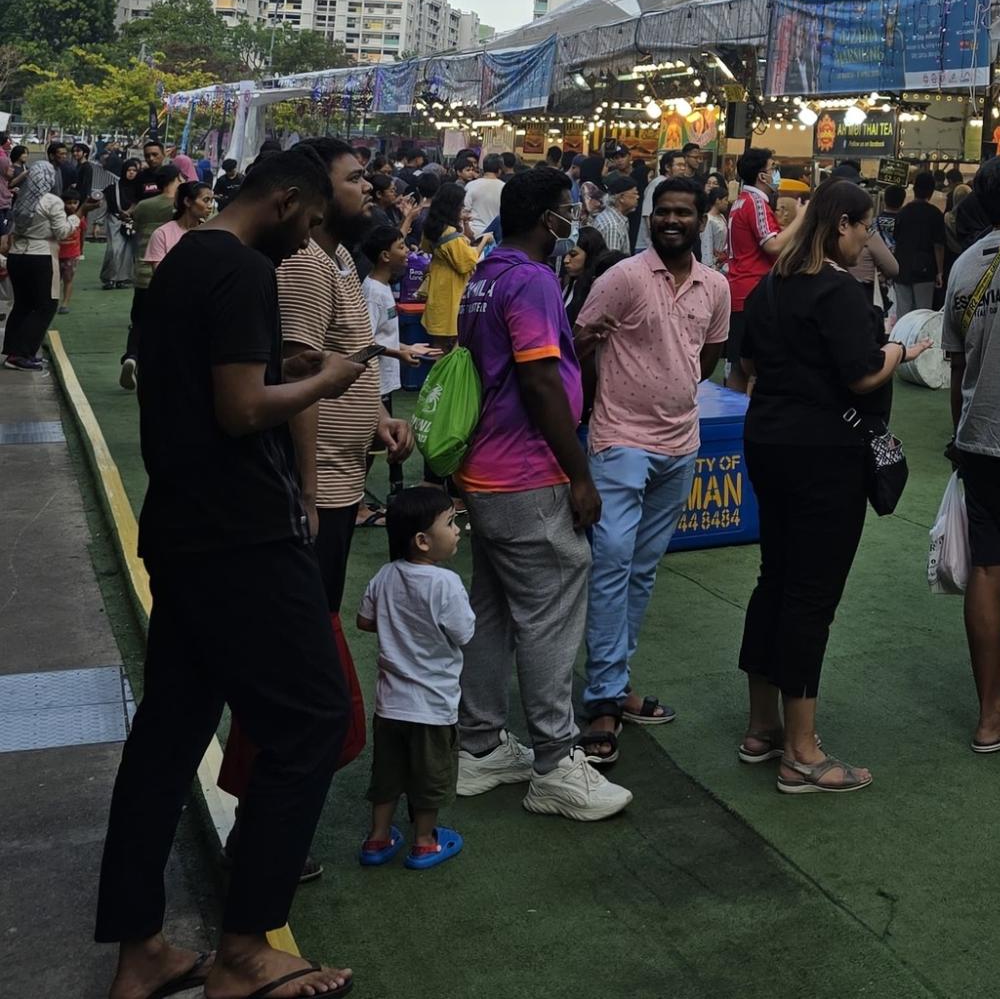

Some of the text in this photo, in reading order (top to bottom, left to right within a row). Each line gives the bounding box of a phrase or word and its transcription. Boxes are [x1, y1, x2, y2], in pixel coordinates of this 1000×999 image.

[695, 454, 741, 473] TY OF
[687, 472, 742, 511] MAN
[678, 507, 741, 532] 44 8484
